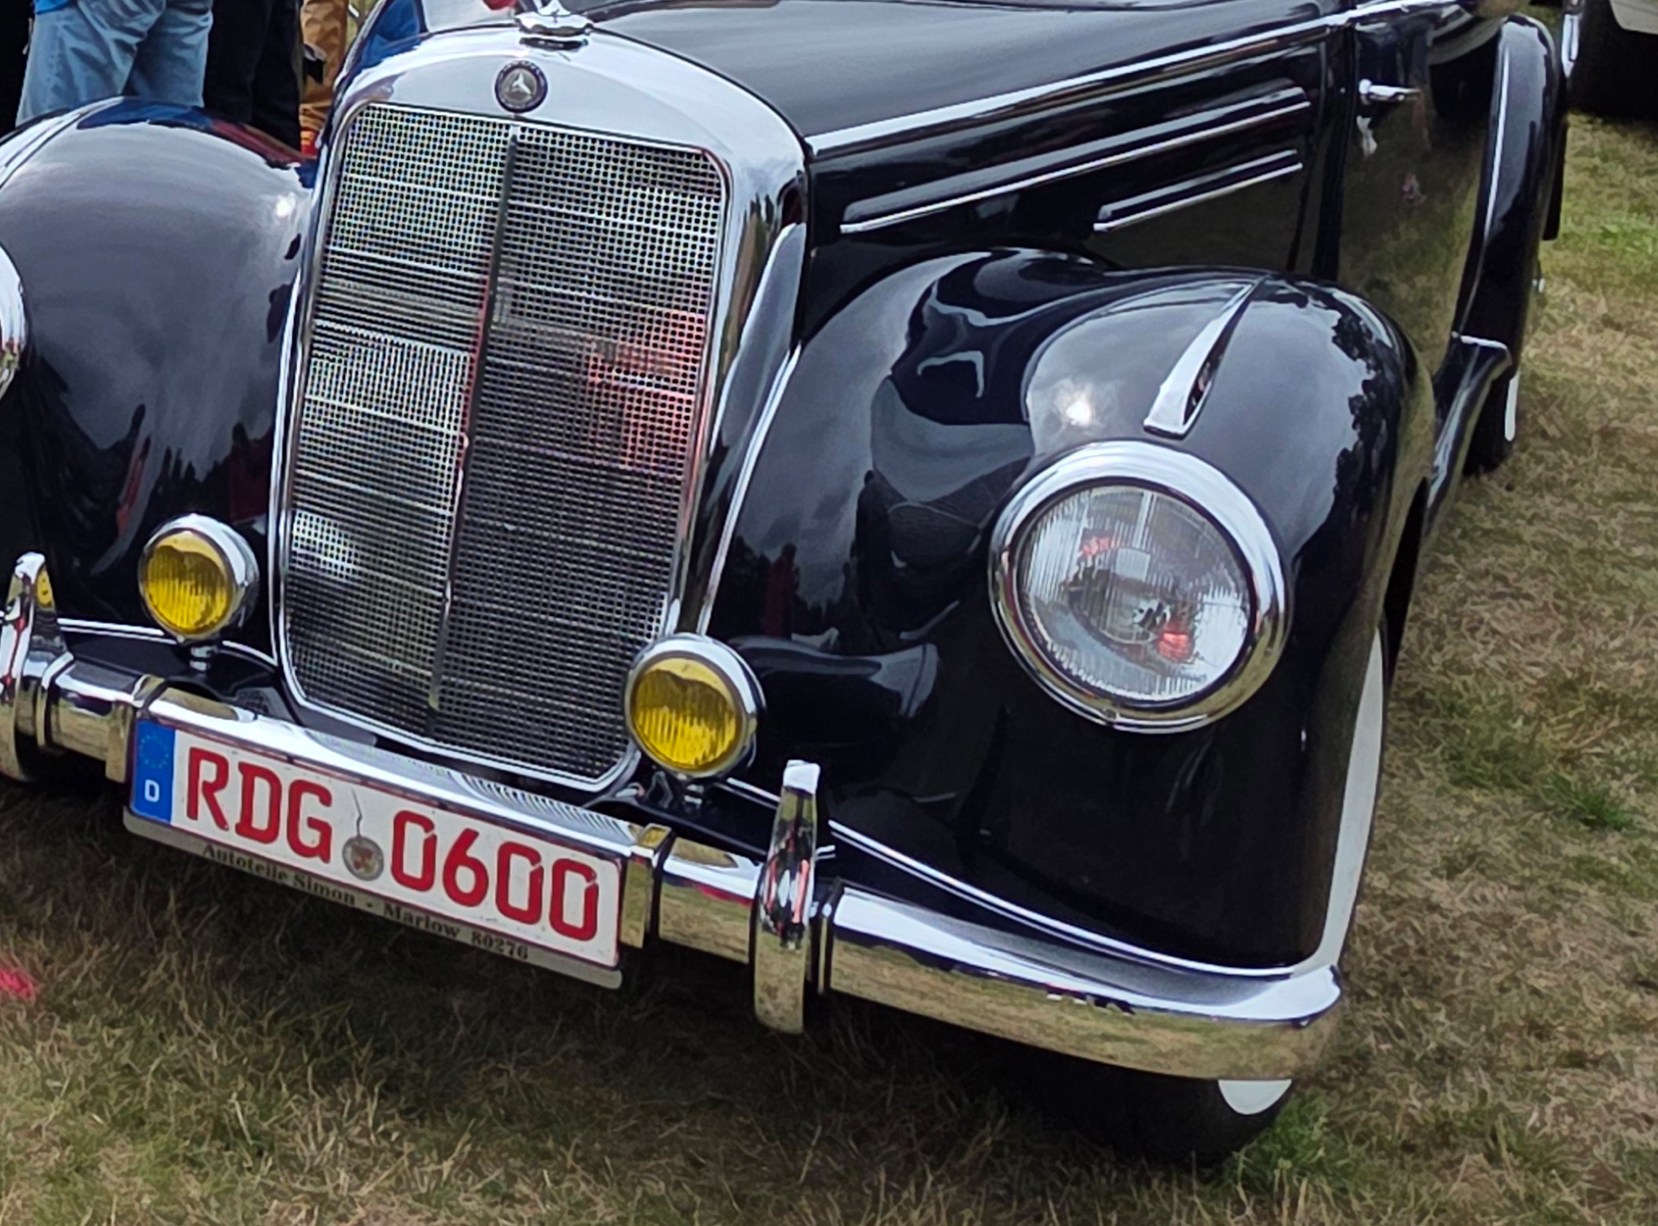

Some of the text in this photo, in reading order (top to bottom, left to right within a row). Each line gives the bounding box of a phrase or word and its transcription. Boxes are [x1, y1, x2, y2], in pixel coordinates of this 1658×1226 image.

[144, 746, 600, 942] D RDG 0600
[202, 843, 289, 882] Autoteile
[292, 873, 356, 906] Simon
[382, 901, 461, 939] Marlow
